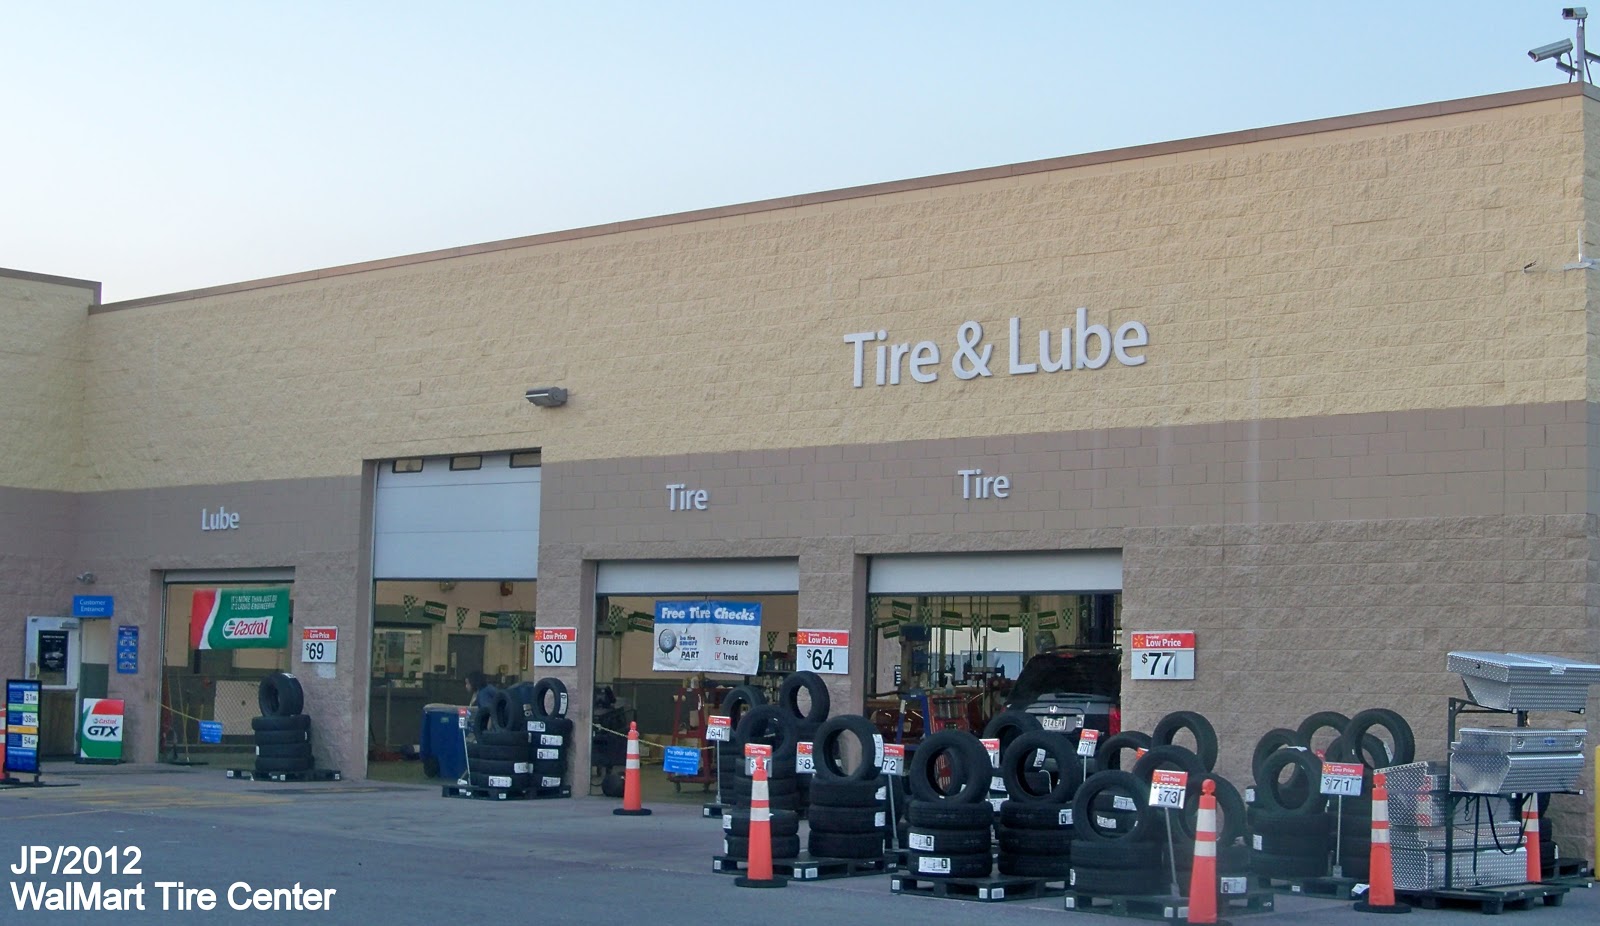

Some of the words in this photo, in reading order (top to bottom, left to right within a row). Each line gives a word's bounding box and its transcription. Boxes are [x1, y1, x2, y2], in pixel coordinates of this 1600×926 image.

[844, 329, 940, 387] Tire
[952, 320, 993, 380] &
[1009, 307, 1148, 374] Lube
[957, 468, 1010, 499] Tire
[666, 483, 708, 511] Tire
[202, 506, 240, 530] Lube
[661, 607, 685, 619] Free
[689, 606, 710, 619] Tire
[714, 607, 755, 620] Checks
[233, 619, 269, 636] Castrol
[723, 637, 749, 646] Pressure
[822, 637, 838, 645] Price
[1146, 639, 1162, 647] Low
[1162, 638, 1181, 647] Price
[305, 642, 324, 660] $69
[540, 644, 563, 664] $60
[723, 652, 739, 661] Tread
[806, 649, 834, 671] $64
[1141, 652, 1175, 675] $77
[87, 725, 120, 737] GTX
[1161, 774, 1169, 782] Low
[1324, 778, 1350, 792] $71
[1158, 790, 1178, 804] $73
